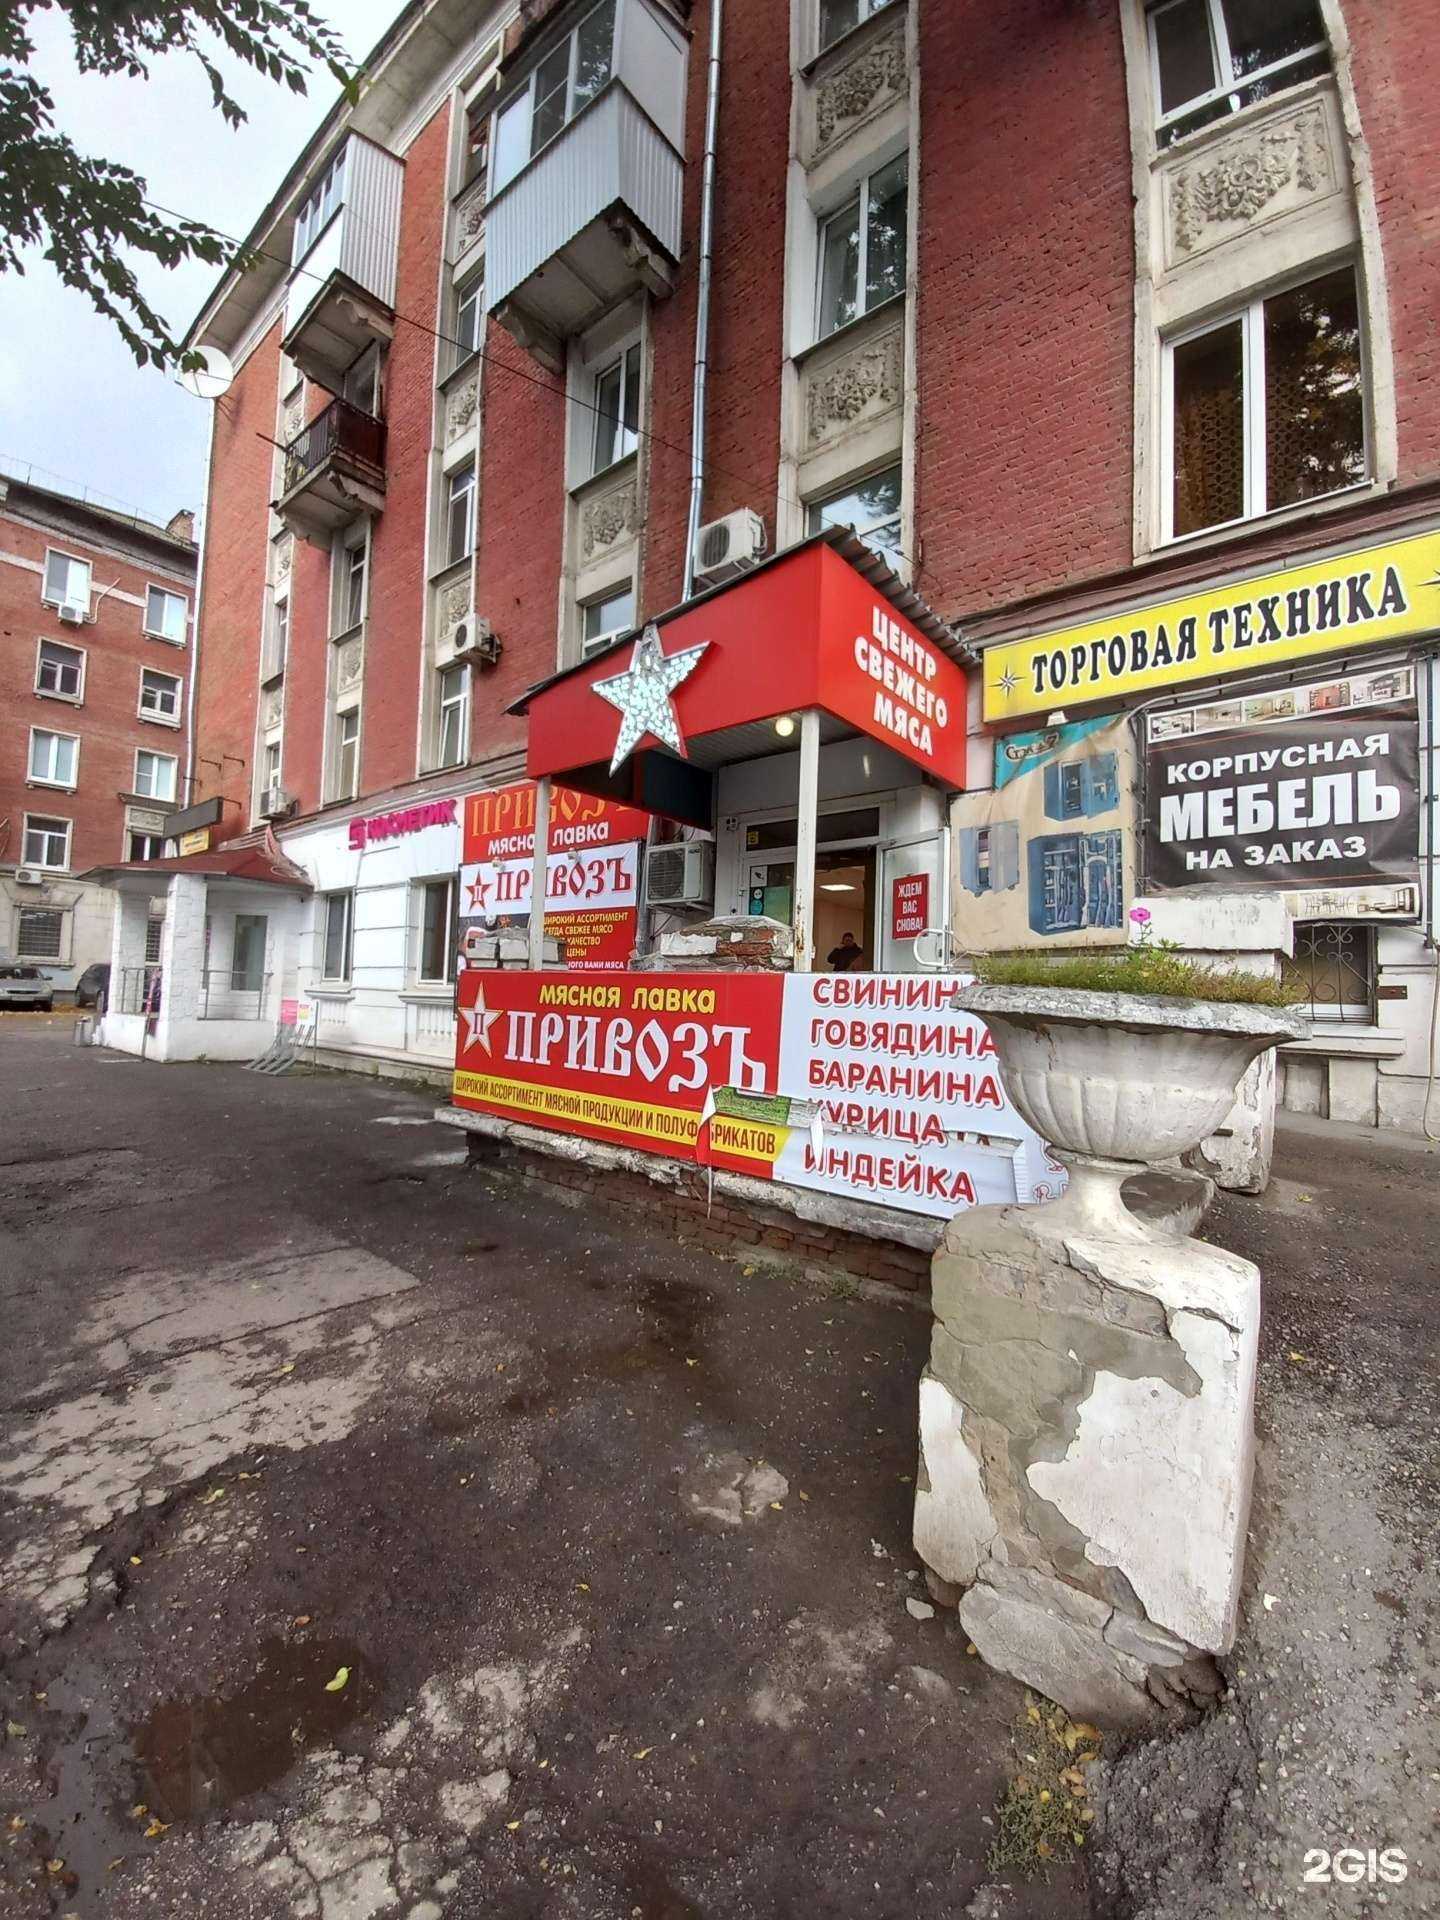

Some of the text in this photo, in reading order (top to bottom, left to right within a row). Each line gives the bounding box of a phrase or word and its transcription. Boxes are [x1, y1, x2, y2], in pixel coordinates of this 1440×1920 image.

[872, 605, 937, 682] ЦЕНТР
[1032, 567, 1407, 693] ТОРГОВАЯ ТЕХНИКА
[855, 636, 948, 728] СВЕЖЕГО
[873, 691, 933, 757] МЯСА
[1167, 733, 1390, 784] КОРПУСНАЯ
[1160, 769, 1401, 842] МЕБЕЛЬ
[1186, 836, 1367, 870] НА ЗАКАЗ
[897, 881, 922, 898] ЖДЕМ
[902, 899, 918, 914] ВАС
[564, 926, 591, 935] СВЕЖЕЕ
[592, 925, 613, 933] МЯСО
[576, 912, 628, 923] АССОРТИМЕНТ
[896, 916, 924, 932] СНОВА!
[584, 961, 604, 969] ВАМИ
[812, 978, 979, 1007] СВИНИН
[503, 1010, 767, 1095] ПРИВОЗЪ
[810, 1018, 999, 1056] ГОВЯДИНА
[456, 1075, 489, 1096] ШИРОКИЙ
[489, 1083, 544, 1108] АССОРТИМЕНТ
[544, 1093, 582, 1115] МЯСНОЙ
[582, 1100, 643, 1128] ПРОДУКЦИИ
[645, 1111, 653, 1130] И
[808, 1059, 1000, 1106] БАРАНИНА
[808, 1098, 945, 1146] УРИЦА
